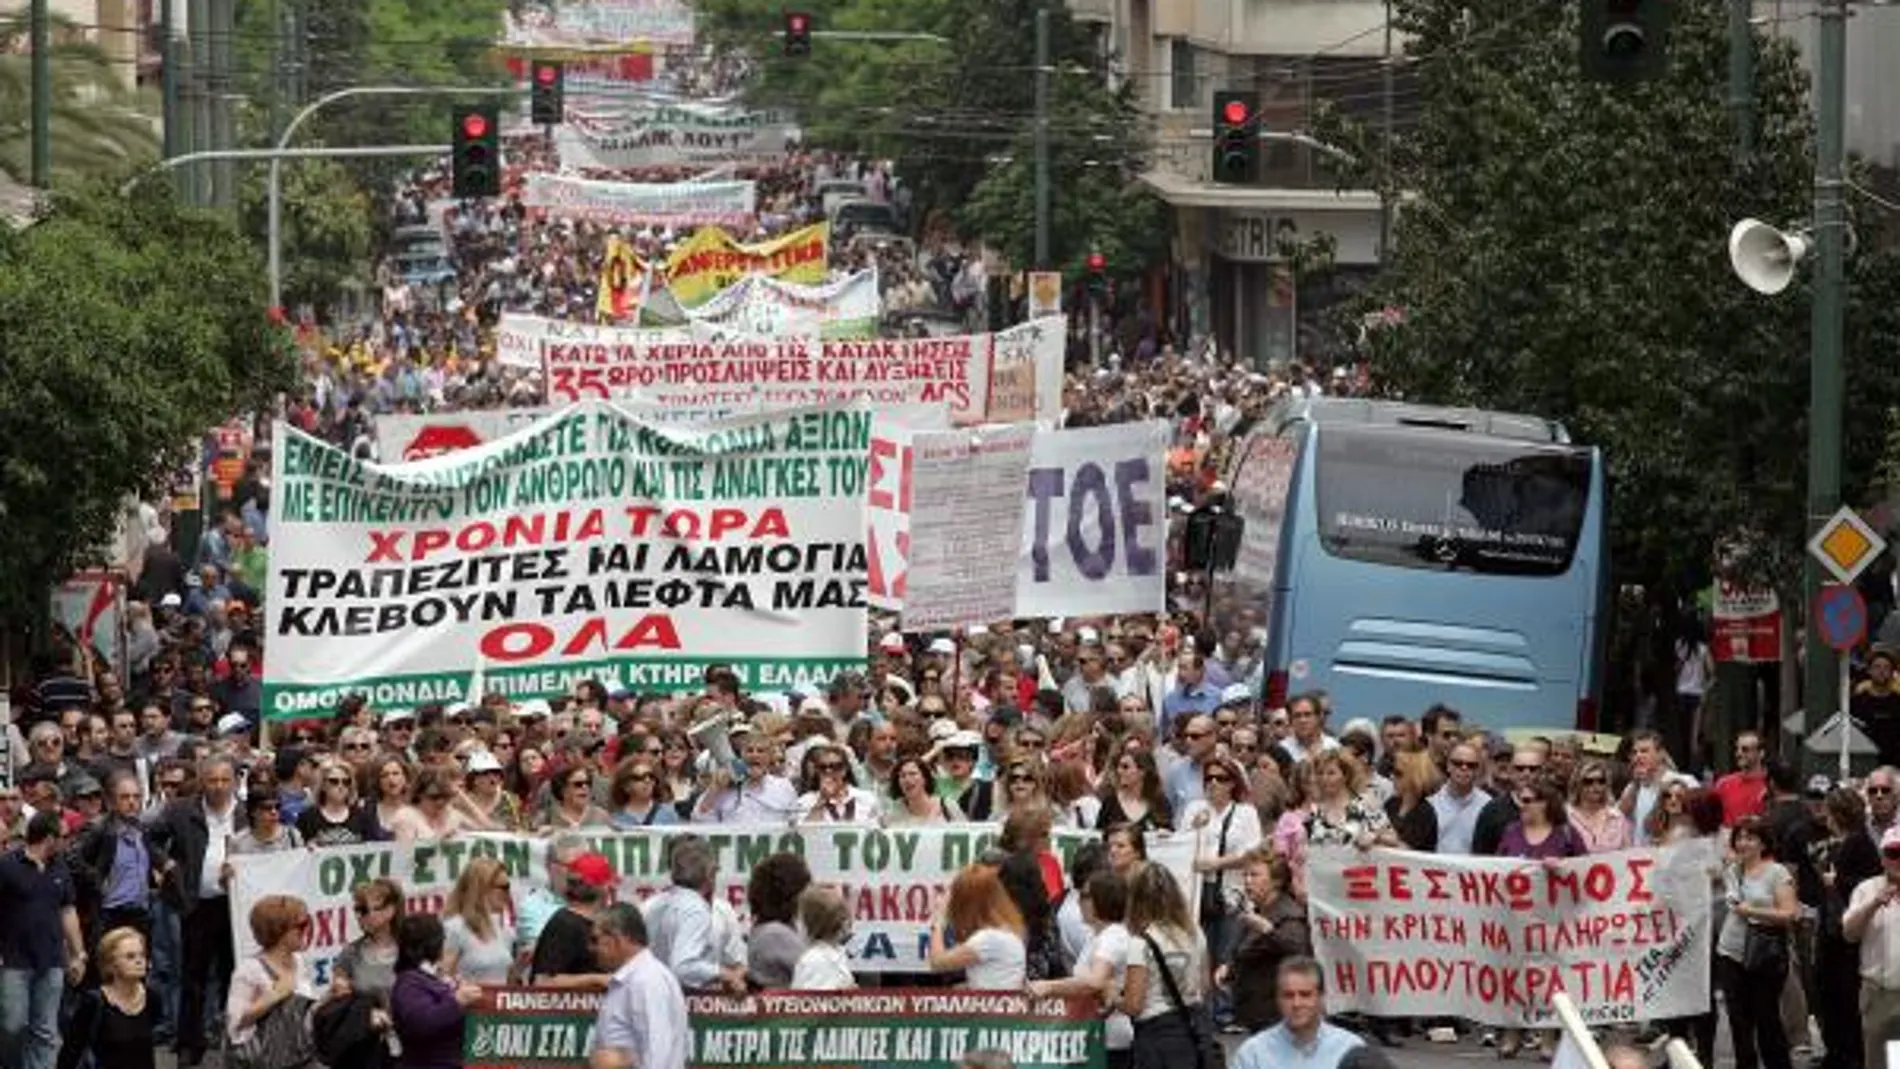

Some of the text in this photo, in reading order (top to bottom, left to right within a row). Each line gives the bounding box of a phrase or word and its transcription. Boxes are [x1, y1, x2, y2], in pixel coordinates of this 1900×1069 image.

[550, 344, 608, 364] ΚΑΤΩ
[786, 411, 872, 450] ΑΞΙΩΝ
[282, 483, 315, 522] ΜΕ
[711, 457, 821, 499] ΑΝΑΓΚΕΣ
[827, 456, 869, 497] ΤΟΥ
[365, 506, 791, 563] ΧΡΟΝΙΑ ΤΩΡΑ
[280, 548, 570, 599] ΤΡΑΠΕΖΙΤΕΣ
[662, 542, 869, 575] ΛΑΜΟΓΙΑ
[278, 590, 518, 637] ΚΛΕΒΟΥΝ
[535, 583, 597, 615] ΤΑ
[771, 579, 869, 610] ΜΑΣ
[479, 612, 683, 663] ΟΛΑ
[319, 850, 393, 896] ΟΧΙ
[832, 829, 919, 873] ΤΟΥ
[1314, 908, 1679, 955] ΤΗΝ ΚΡΙΣΗ ΝΑ ΠΛΗΡΩΣΕΙ
[1335, 961, 1357, 995] Η
[1367, 956, 1636, 1007] ΠΛΟΥΤΟΚΡΑΤΙΑ
[537, 1023, 577, 1058] ΣΤΑ
[702, 1028, 771, 1063] ΜΕΤΡΑ
[778, 1028, 808, 1060] ΤΙΣ
[812, 1027, 890, 1060] ΑΔΙΚΙΕΣ
[895, 1027, 932, 1060] ΚΑΙ
[939, 1028, 970, 1060] ΤΙΣ
